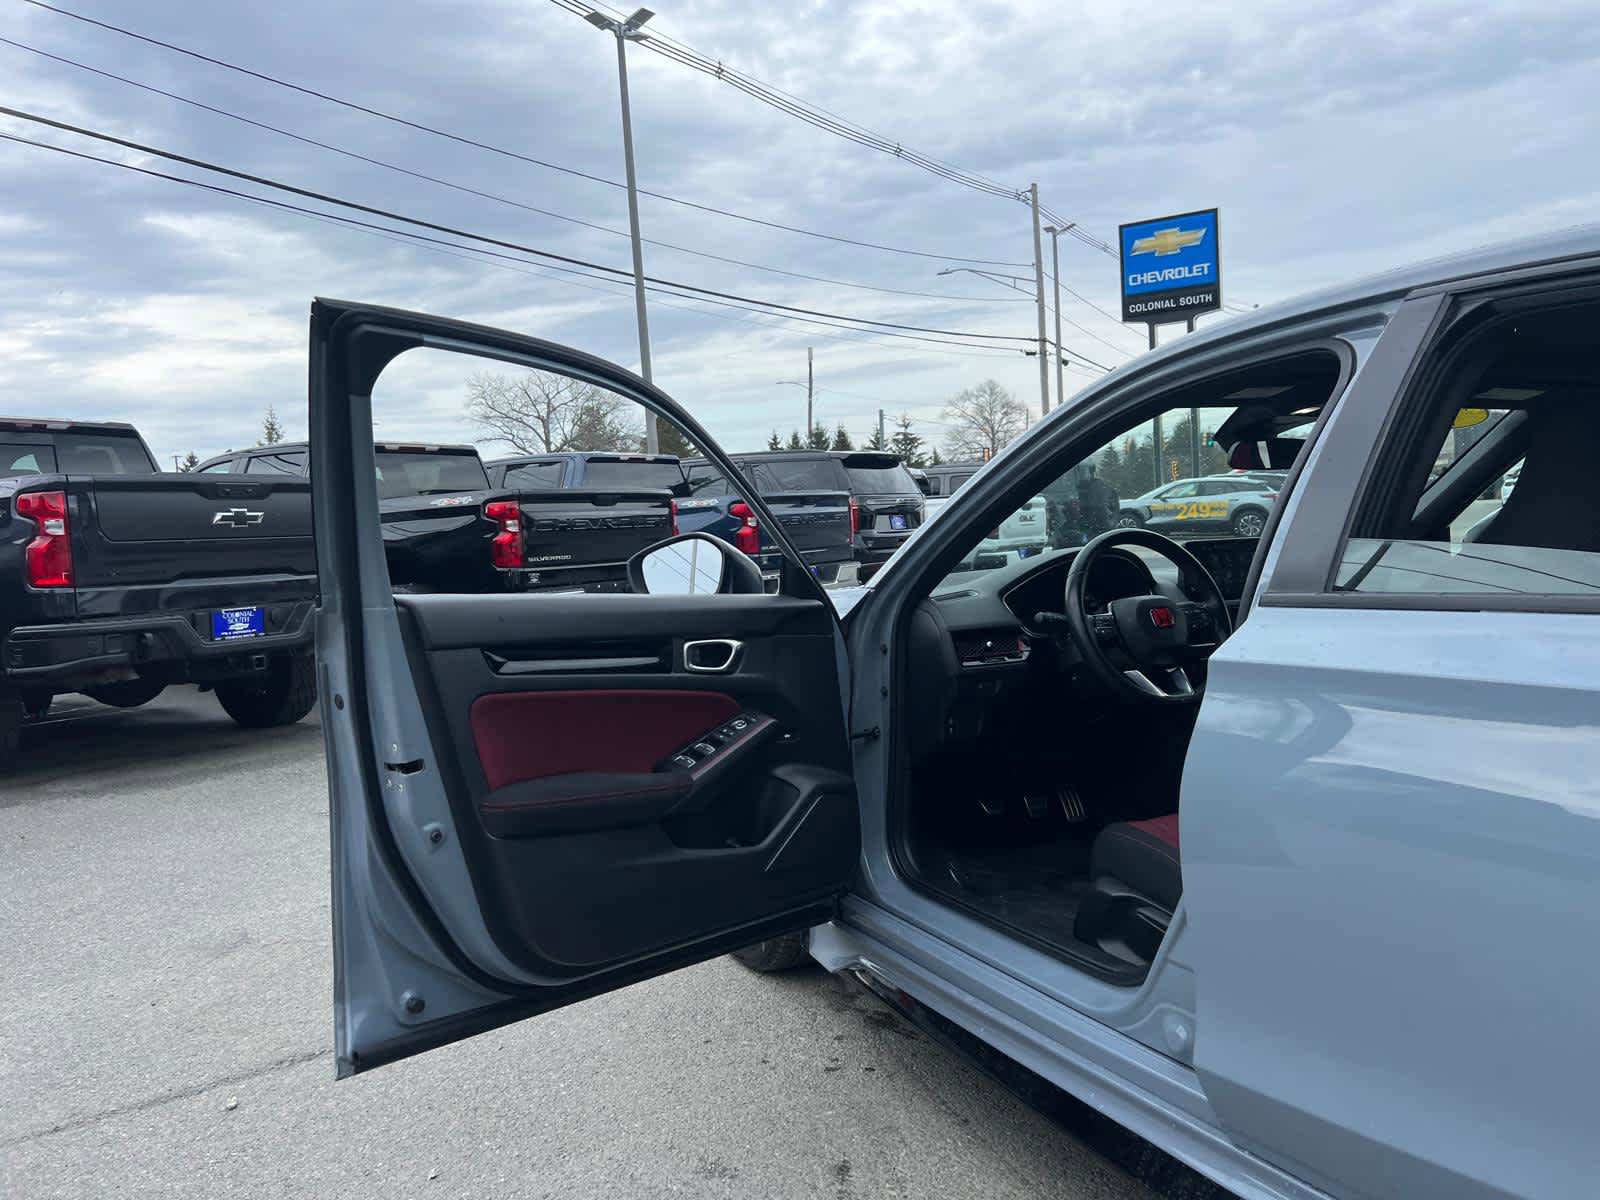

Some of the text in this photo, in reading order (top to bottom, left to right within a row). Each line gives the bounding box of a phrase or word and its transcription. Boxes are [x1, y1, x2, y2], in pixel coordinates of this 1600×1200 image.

[1128, 263, 1211, 286] CHEVROLET
[1129, 294, 1213, 312] COLONIAL SOUTH
[1176, 502, 1210, 521] 249
[527, 554, 572, 562] SILVERADO
